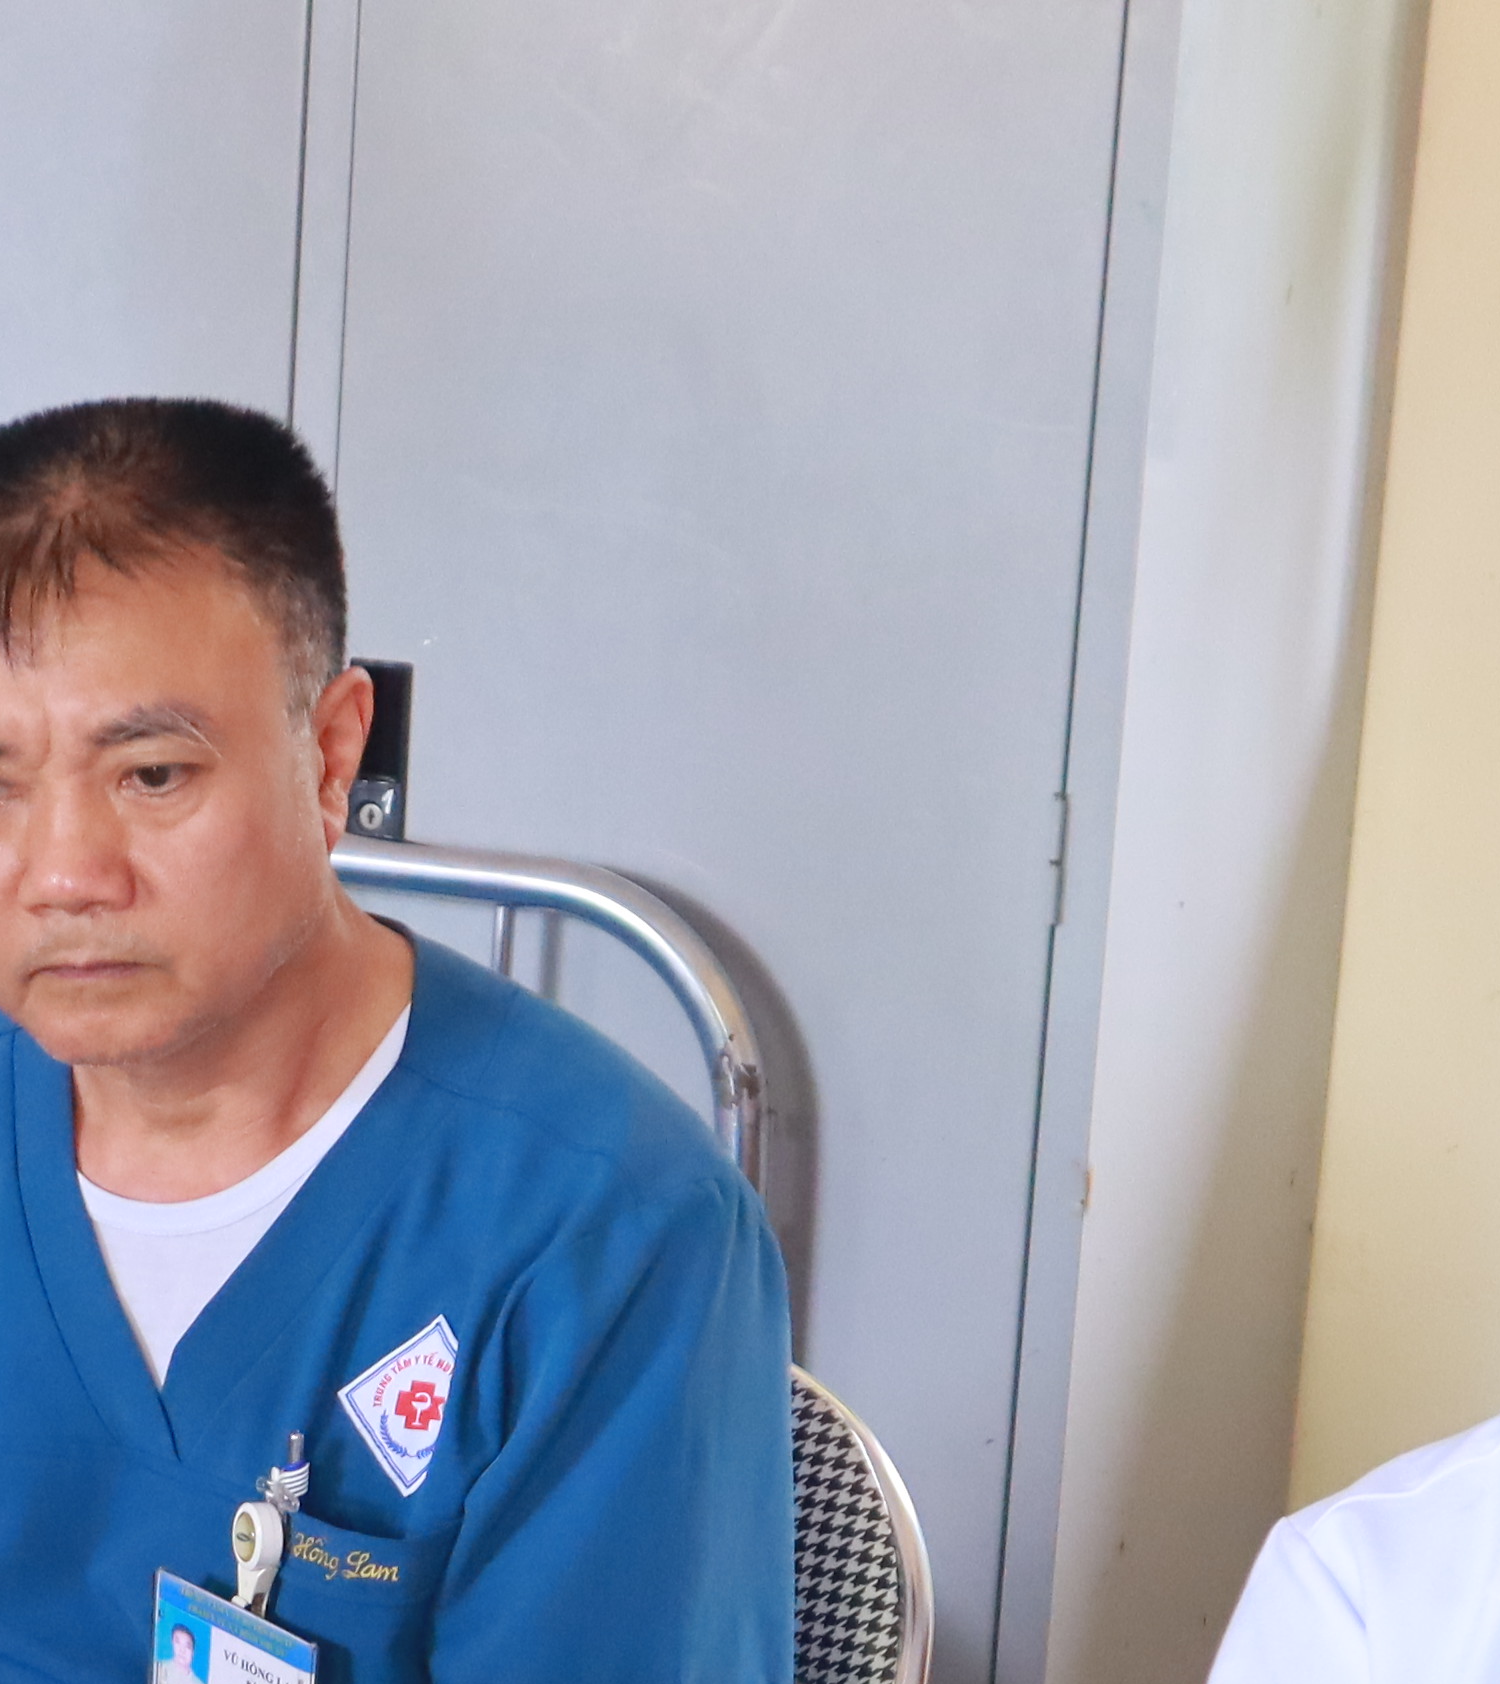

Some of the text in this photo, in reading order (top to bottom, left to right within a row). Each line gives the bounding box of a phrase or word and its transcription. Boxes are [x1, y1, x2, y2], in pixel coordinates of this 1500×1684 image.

[372, 1372, 392, 1407] TRUNG
[391, 1358, 411, 1374] TÂM
[415, 1354, 421, 1364] Y
[341, 1550, 399, 1583] Lam
